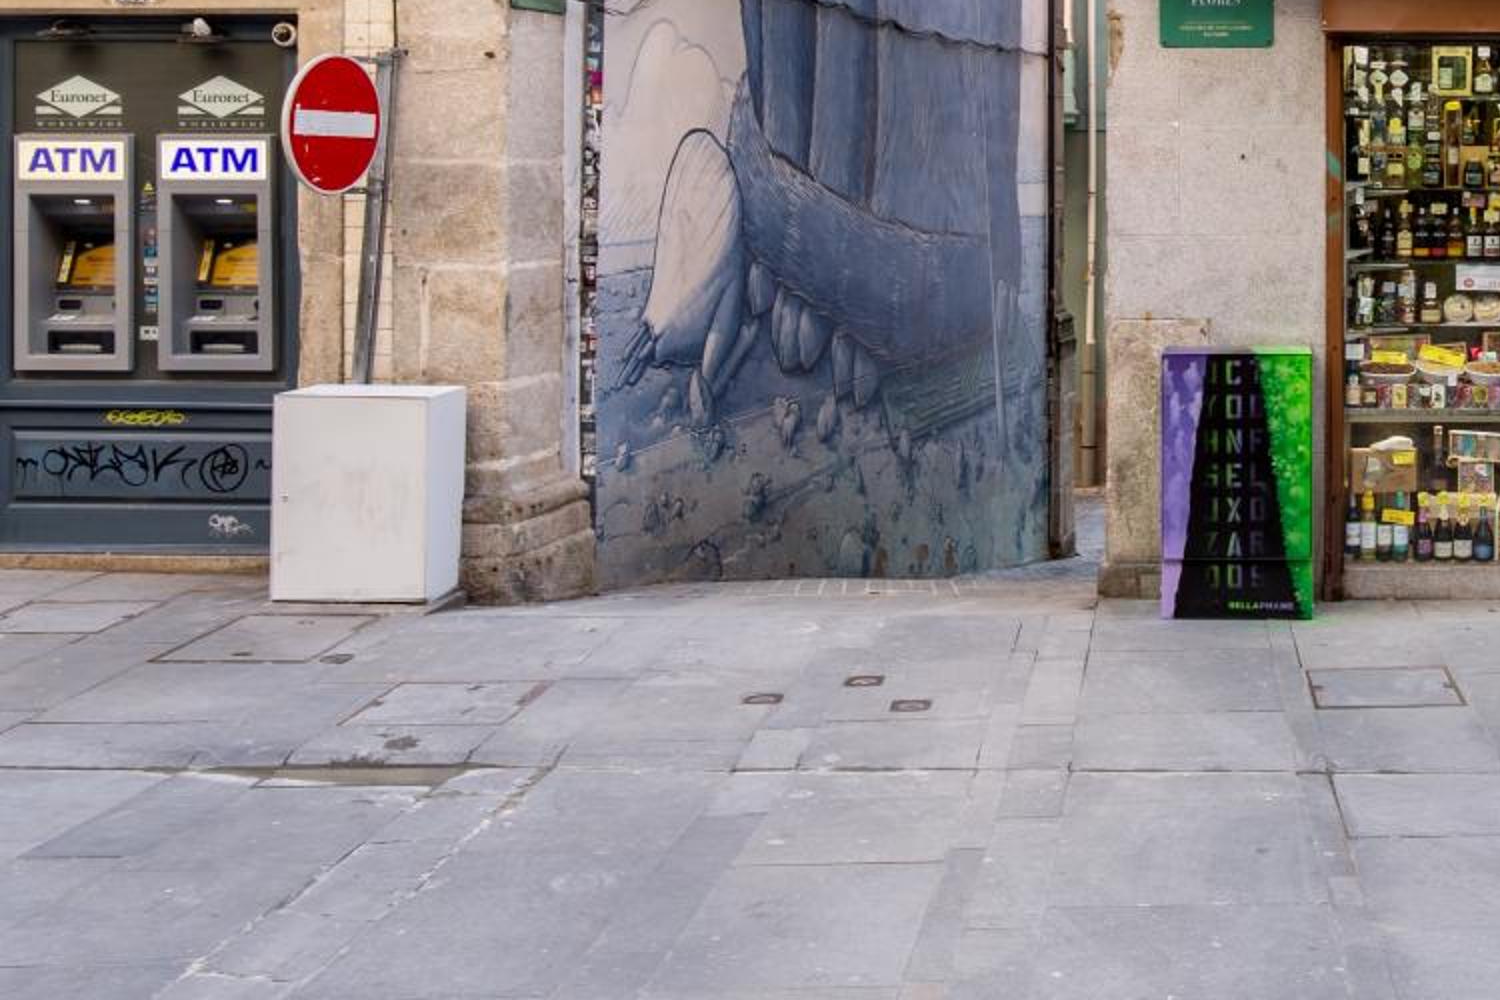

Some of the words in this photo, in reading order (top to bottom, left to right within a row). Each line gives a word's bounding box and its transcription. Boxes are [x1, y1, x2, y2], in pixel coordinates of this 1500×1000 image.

[50, 89, 108, 104] Euronet
[192, 89, 250, 104] Euronet
[28, 147, 117, 173] ATM
[170, 147, 258, 173] ATM
